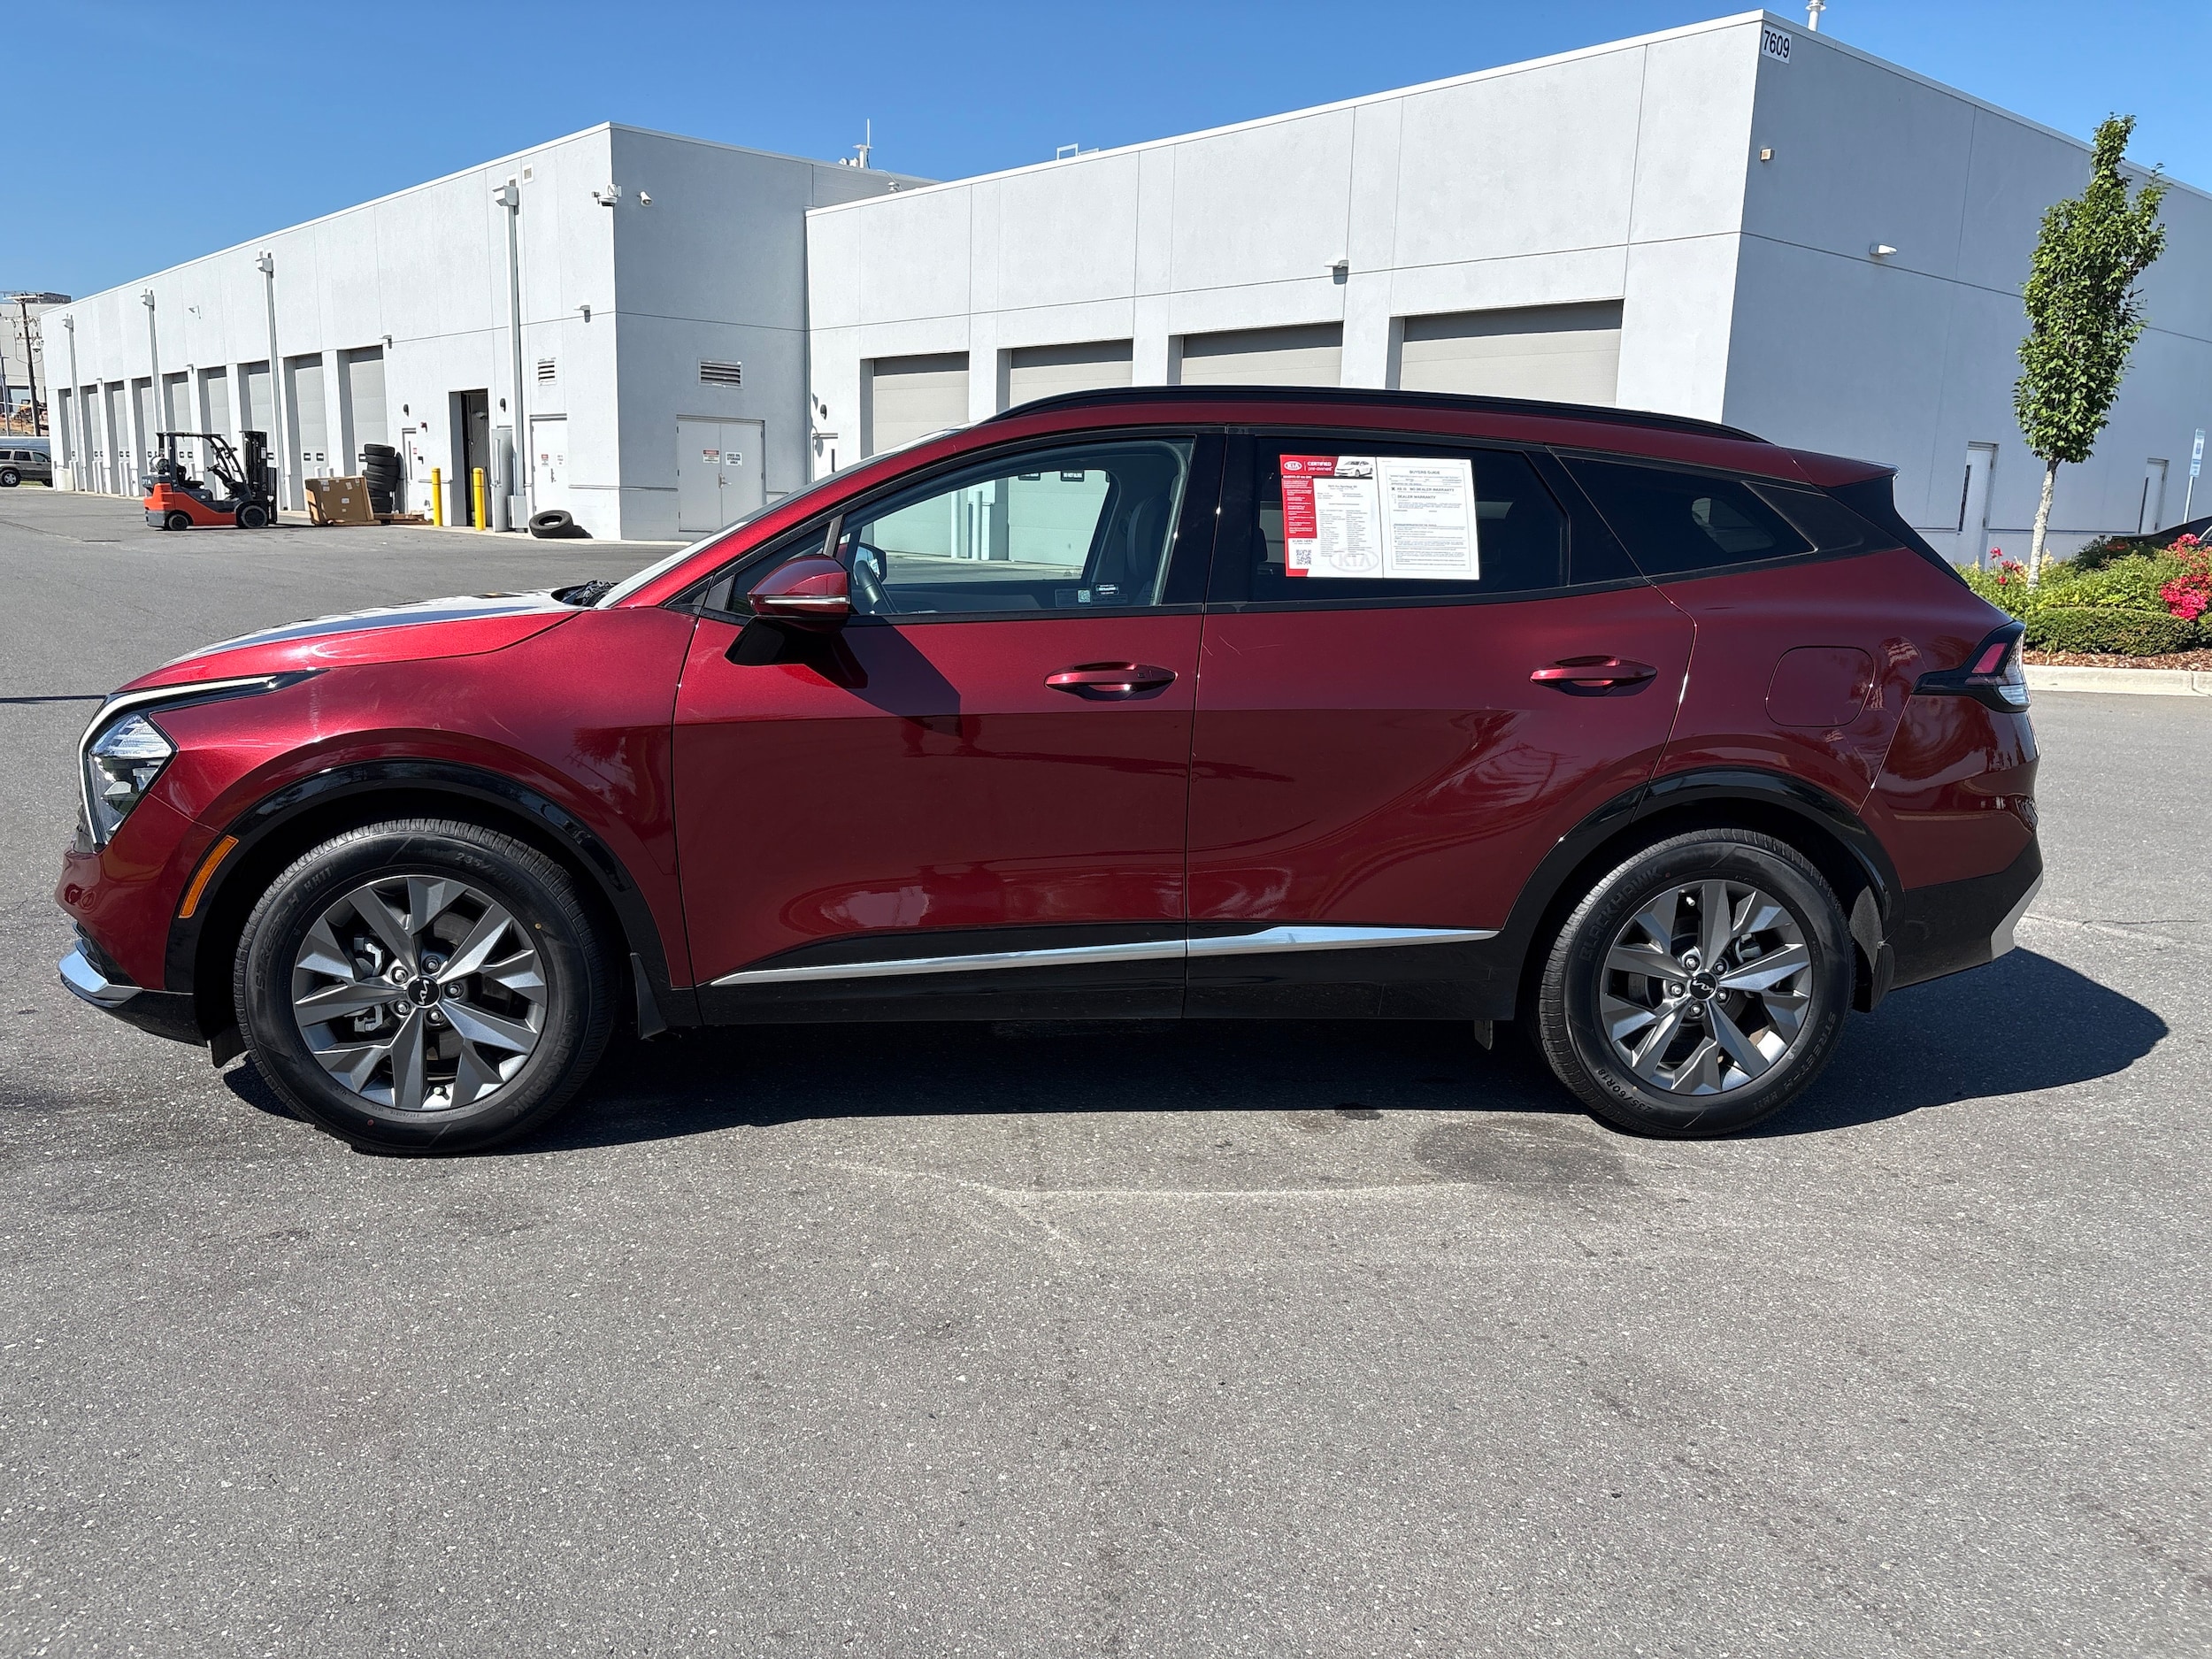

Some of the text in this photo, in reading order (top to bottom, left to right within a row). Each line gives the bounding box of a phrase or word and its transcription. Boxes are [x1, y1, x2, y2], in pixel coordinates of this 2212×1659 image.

[1764, 29, 1790, 58] 7609
[1338, 553, 1372, 567] KIA
[1578, 865, 1663, 962] BLACKHAWK
[1597, 1068, 1655, 1114] 235/60R18
